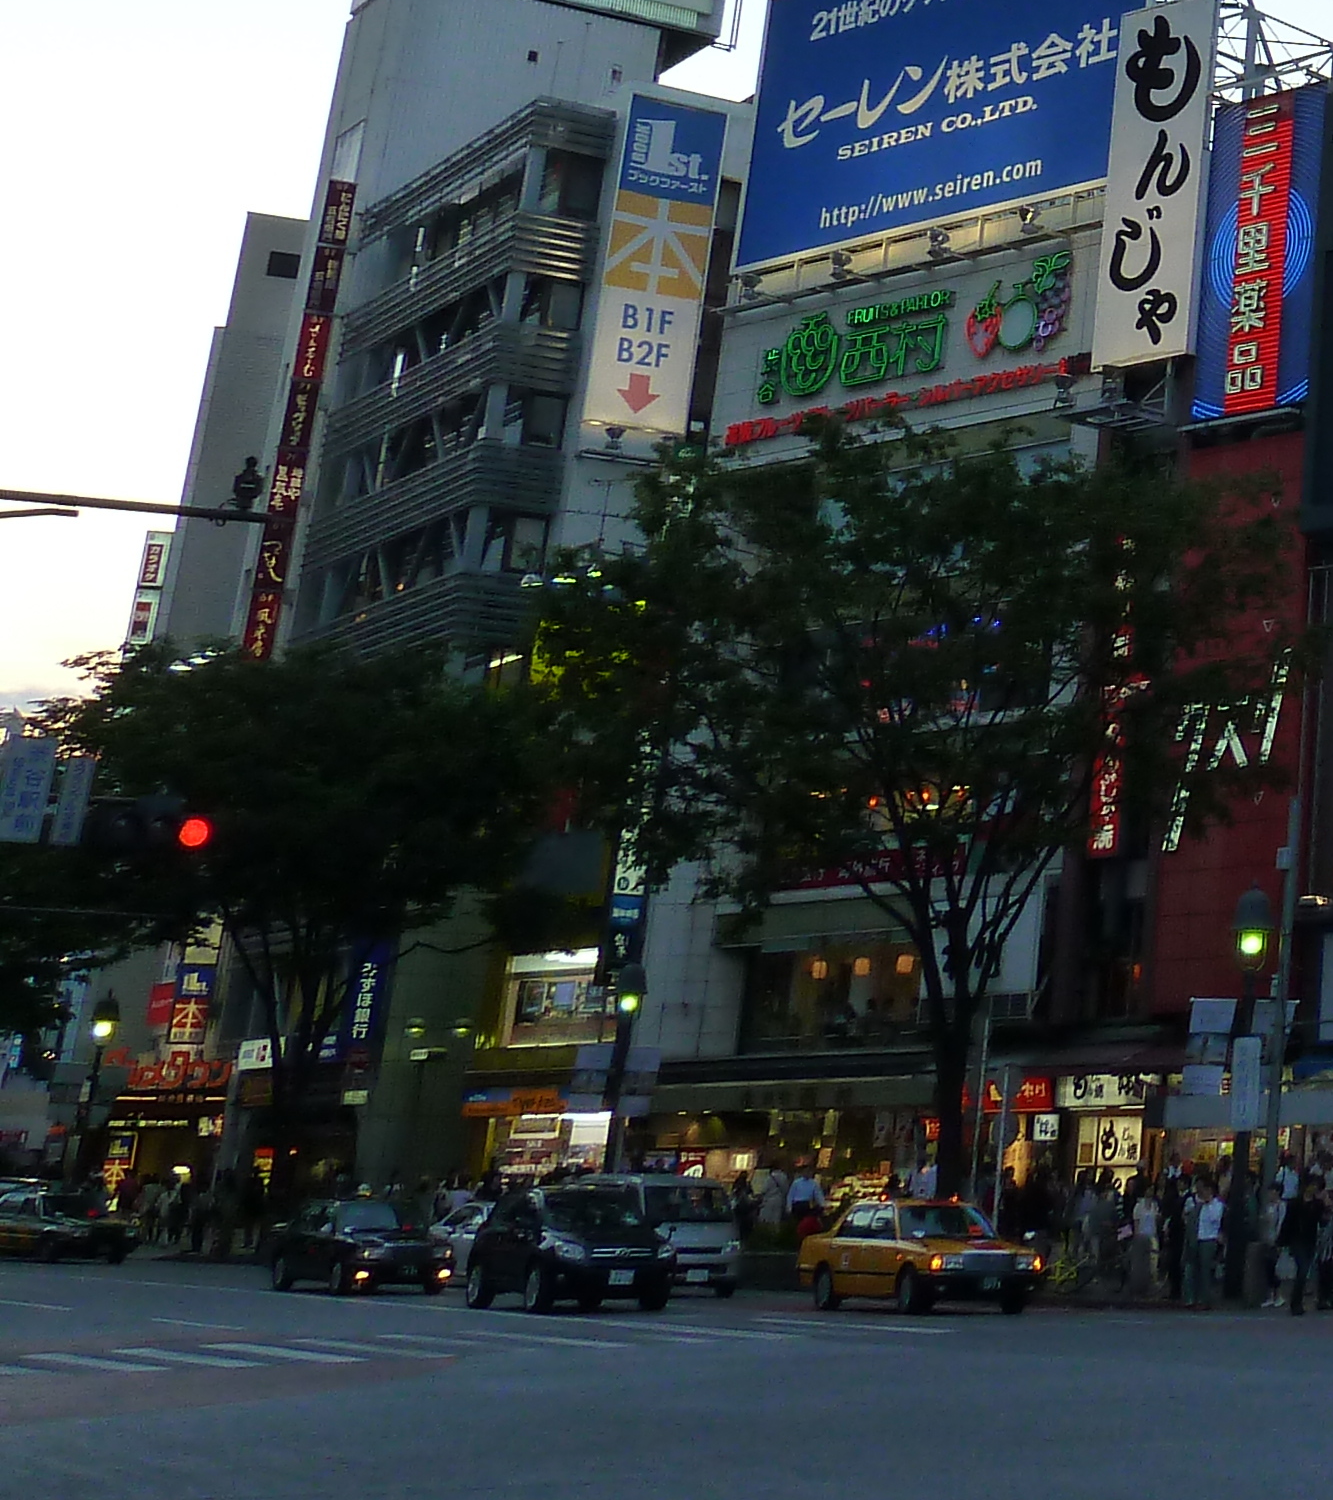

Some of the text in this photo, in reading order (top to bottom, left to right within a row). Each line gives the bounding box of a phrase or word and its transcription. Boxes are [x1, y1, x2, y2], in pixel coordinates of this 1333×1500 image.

[776, 16, 1119, 149] セーレン株式会社
[836, 96, 1038, 161] SEIREN CO.,LTD.
[627, 169, 709, 195] ブックファースト
[819, 156, 1043, 229] http://www.seiren.com
[1109, 14, 1202, 347] もんじゃ
[1224, 102, 1281, 395] 三千里薬品
[616, 336, 671, 369] B2F
[621, 303, 675, 336] B1F
